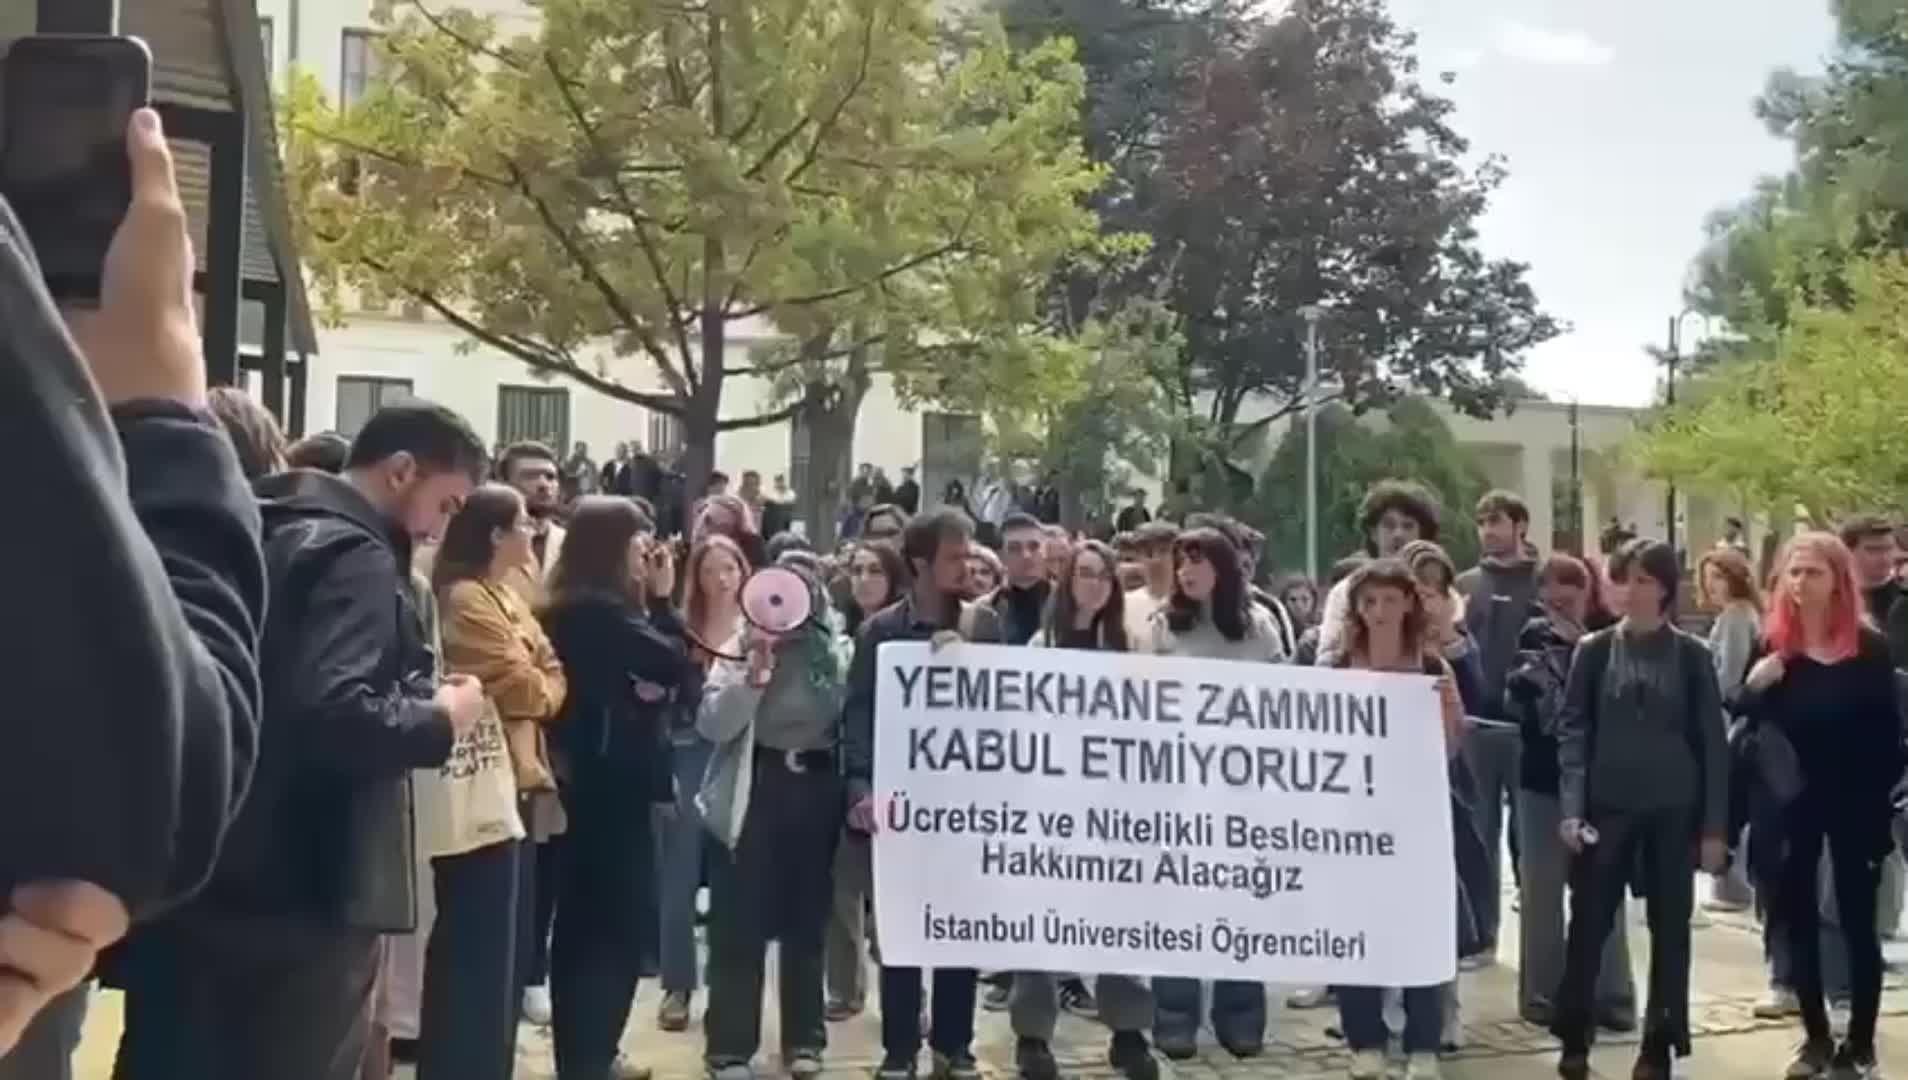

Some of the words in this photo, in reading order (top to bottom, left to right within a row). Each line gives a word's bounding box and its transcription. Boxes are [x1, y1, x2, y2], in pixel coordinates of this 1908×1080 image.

[893, 665, 1183, 723] YEMEKHANE
[1196, 683, 1388, 738] ZAMMINI
[908, 727, 1066, 776] KABUL
[1082, 732, 1351, 794] ETMİYORUZ
[1363, 753, 1375, 796] !
[887, 791, 1028, 835] Ücretsiz
[1039, 813, 1075, 838] ve
[1087, 807, 1213, 848] Nitelikli
[1225, 815, 1396, 857] Beslenme
[981, 841, 1143, 884] Hakkımızı
[1154, 852, 1304, 899] Alacağız
[924, 904, 1035, 943] İstanbul
[1042, 909, 1203, 953] Üniversitesi
[1211, 917, 1367, 963] Öğrencileri
